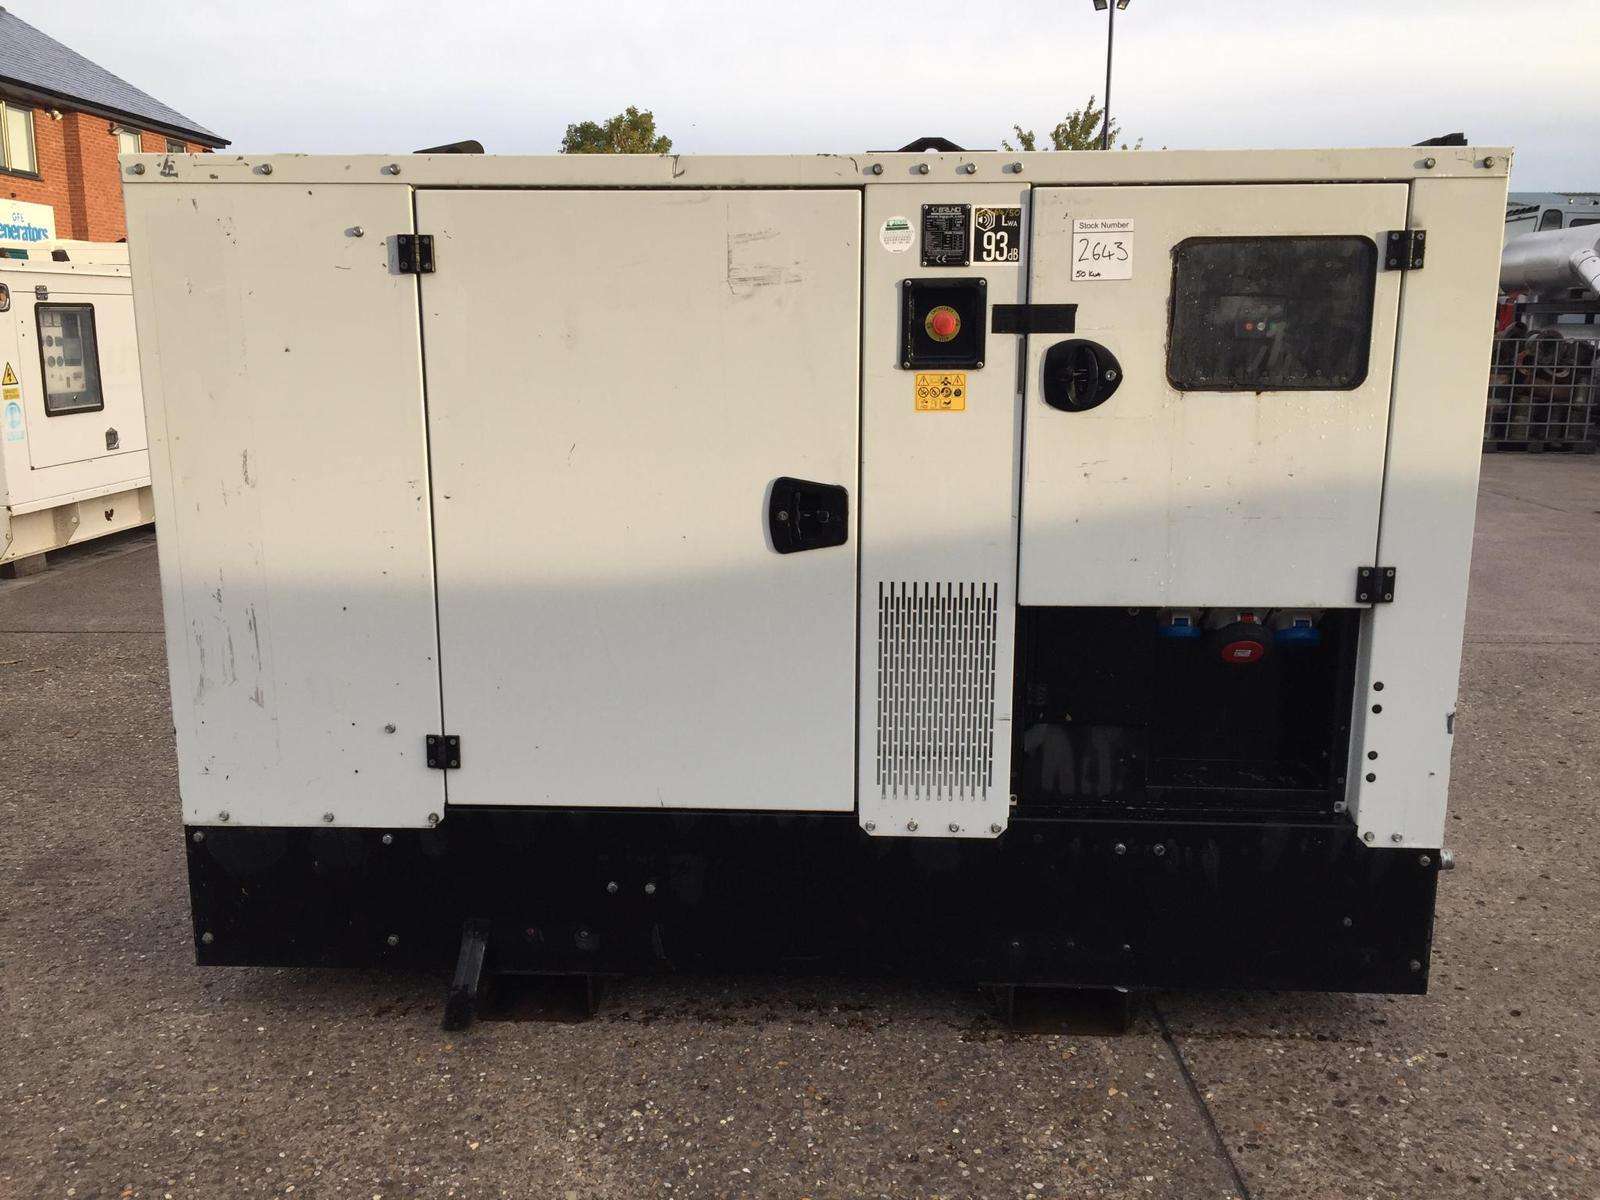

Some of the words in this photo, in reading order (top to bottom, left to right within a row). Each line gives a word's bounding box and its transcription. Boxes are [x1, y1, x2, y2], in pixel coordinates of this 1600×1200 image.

[1079, 222, 1098, 230] Stock
[1101, 221, 1129, 229] Number
[1078, 238, 1129, 262] 2643
